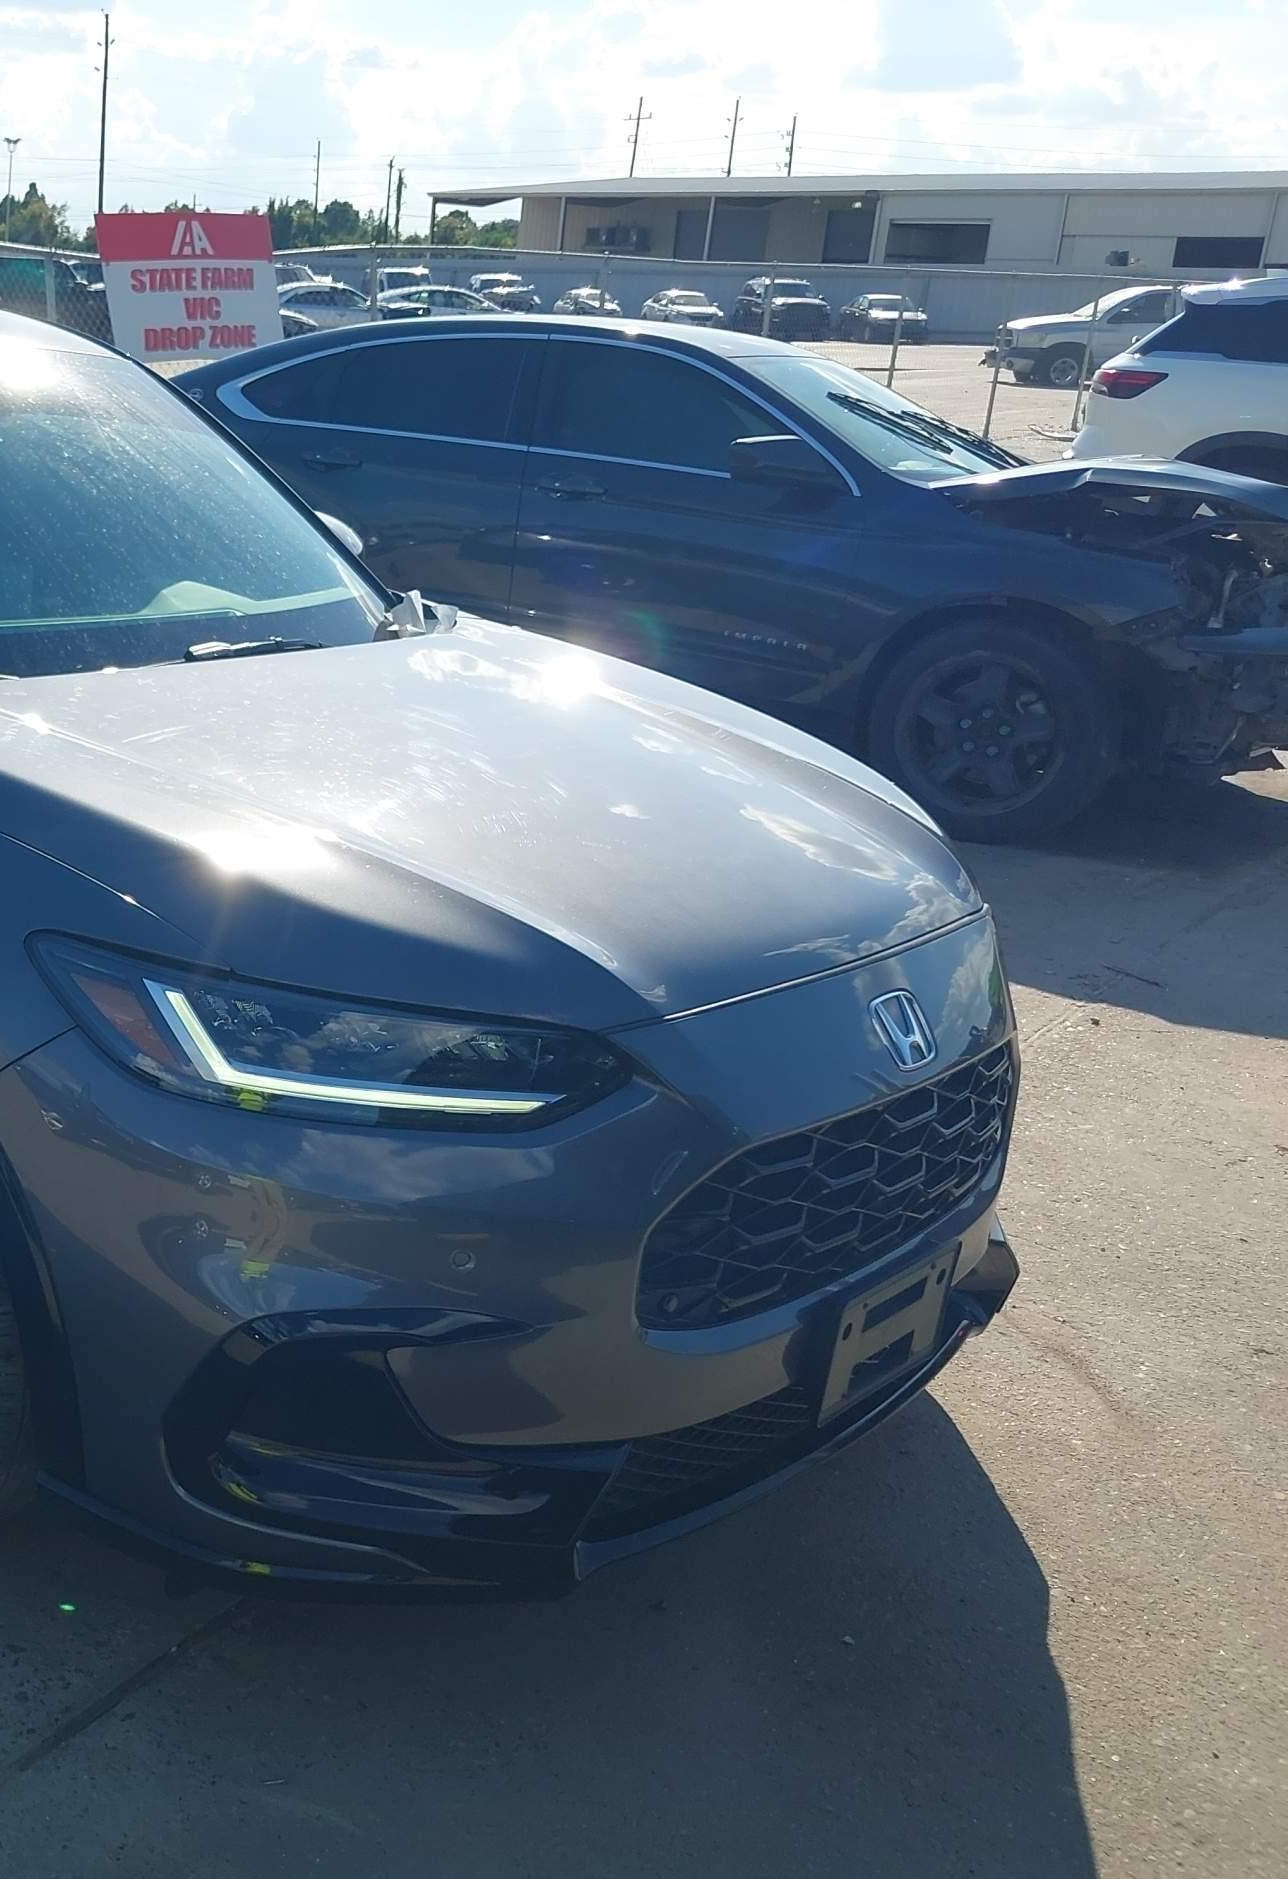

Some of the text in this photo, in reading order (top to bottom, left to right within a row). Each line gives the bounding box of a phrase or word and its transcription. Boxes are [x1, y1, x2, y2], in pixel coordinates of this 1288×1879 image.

[130, 267, 254, 294] STATE FARM
[184, 296, 222, 321] VIC
[143, 324, 257, 352] DROP ZONE
